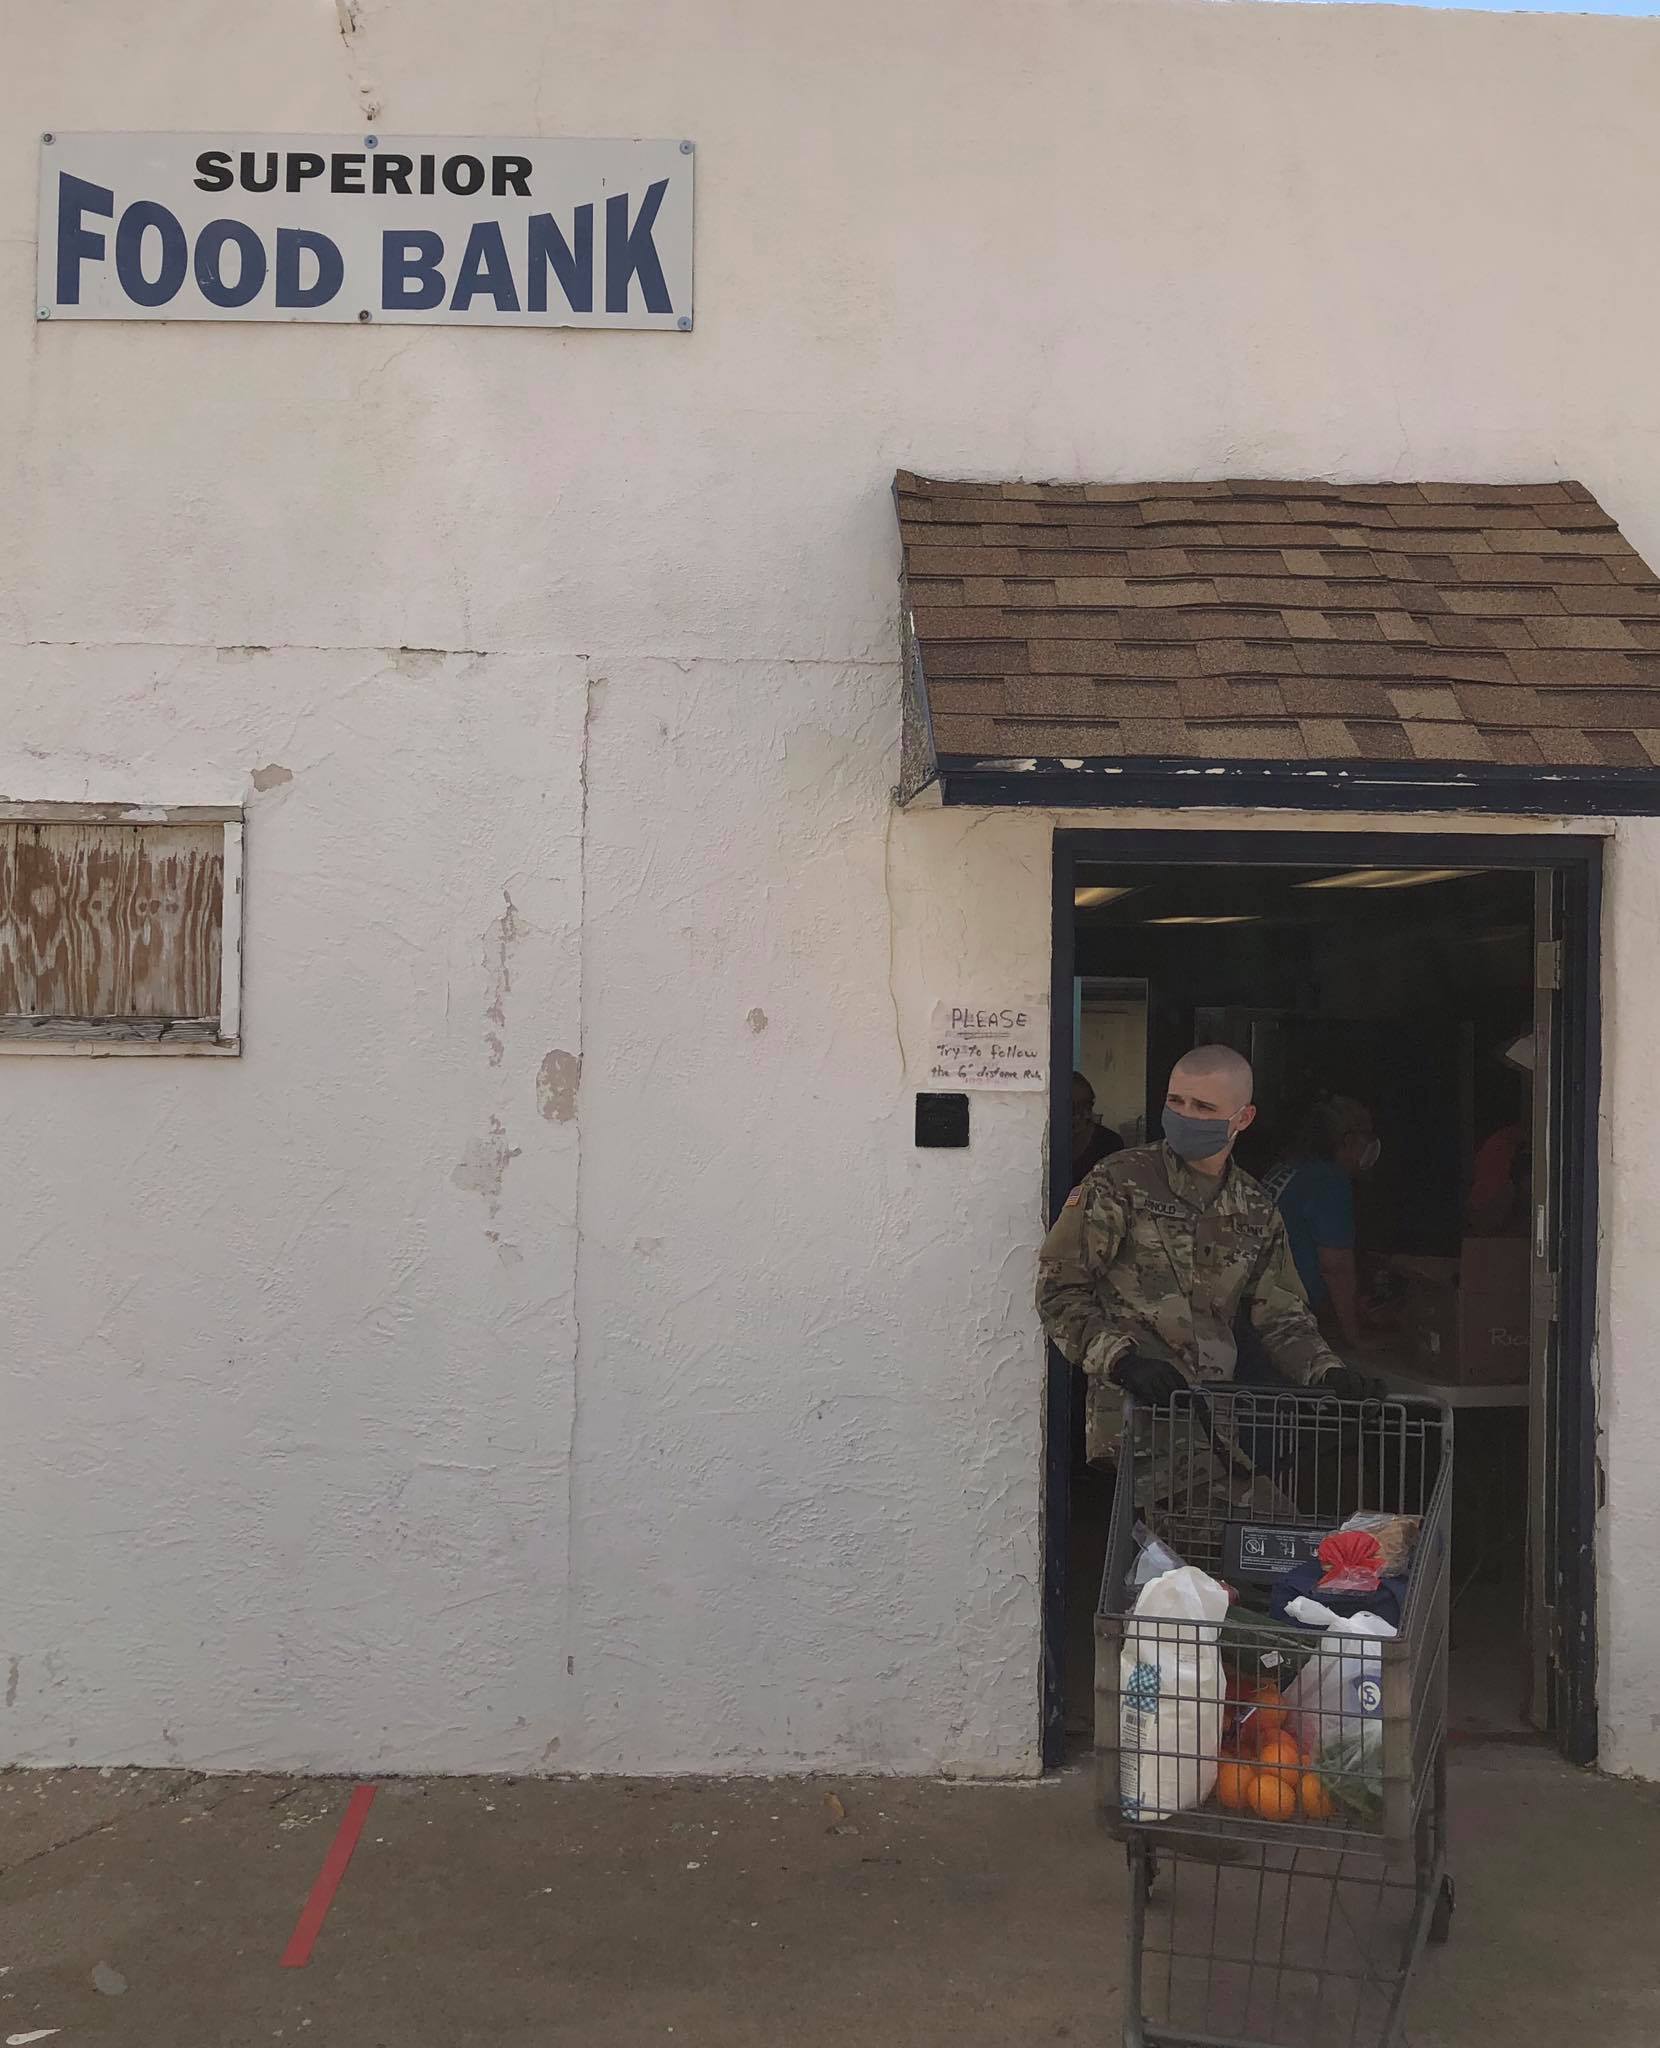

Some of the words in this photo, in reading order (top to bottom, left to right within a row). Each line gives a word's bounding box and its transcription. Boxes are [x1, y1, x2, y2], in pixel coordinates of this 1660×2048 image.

[193, 150, 532, 197] SUPERIOR
[56, 170, 345, 309] FOOD
[381, 177, 674, 315] BANK
[952, 1008, 1027, 1029] PLEASE
[990, 1044, 1038, 1060] follow
[931, 1064, 950, 1078] the
